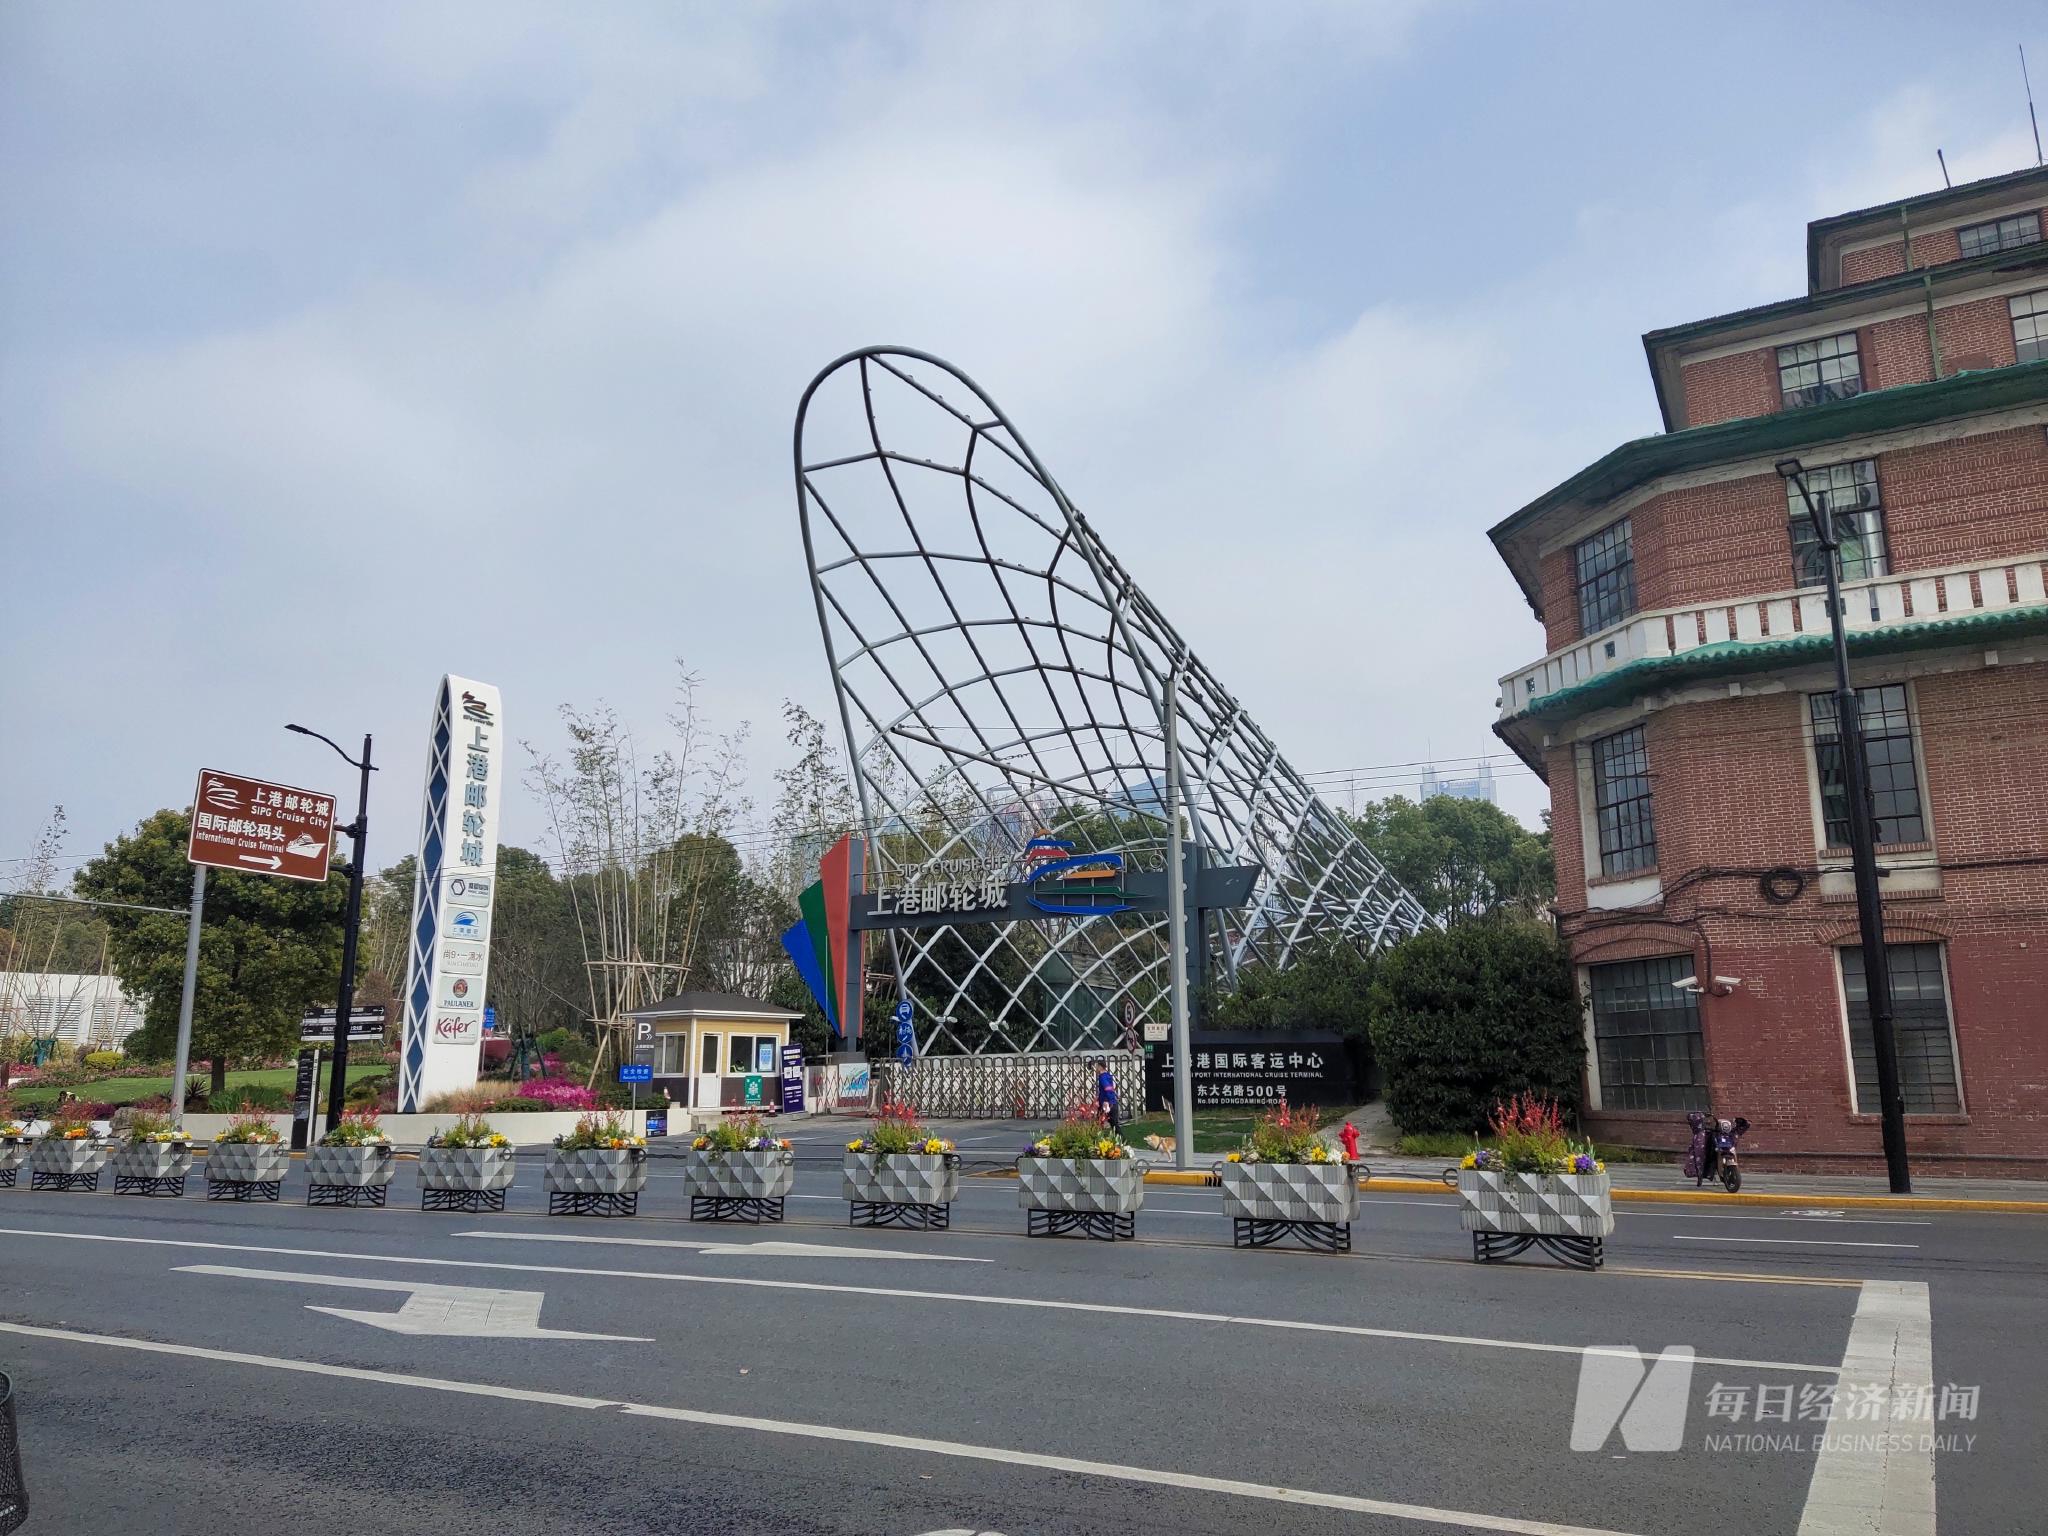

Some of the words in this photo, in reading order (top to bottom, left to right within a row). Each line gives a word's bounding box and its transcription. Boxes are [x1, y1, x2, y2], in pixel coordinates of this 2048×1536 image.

[251, 787, 329, 817] 上港邮轮城
[460, 726, 489, 867] 上港邮轮城
[197, 812, 286, 842] 国际邮轮码头
[251, 805, 272, 817] SIPG
[276, 810, 305, 823] Cruise
[309, 816, 328, 829] City
[196, 830, 236, 846] International
[238, 837, 257, 850] Cruise
[259, 840, 284, 854] Terminal
[897, 861, 928, 877] SIPG
[930, 857, 979, 875] CRUISE
[867, 877, 1009, 916] 上港邮轮城
[443, 1000, 474, 1008] PAULANER
[435, 1016, 477, 1039] Käfer
[637, 1023, 651, 1041] P
[1161, 1052, 1324, 1069] 上港国际客运中心
[1197, 1084, 1288, 1097] 东大名路500号
